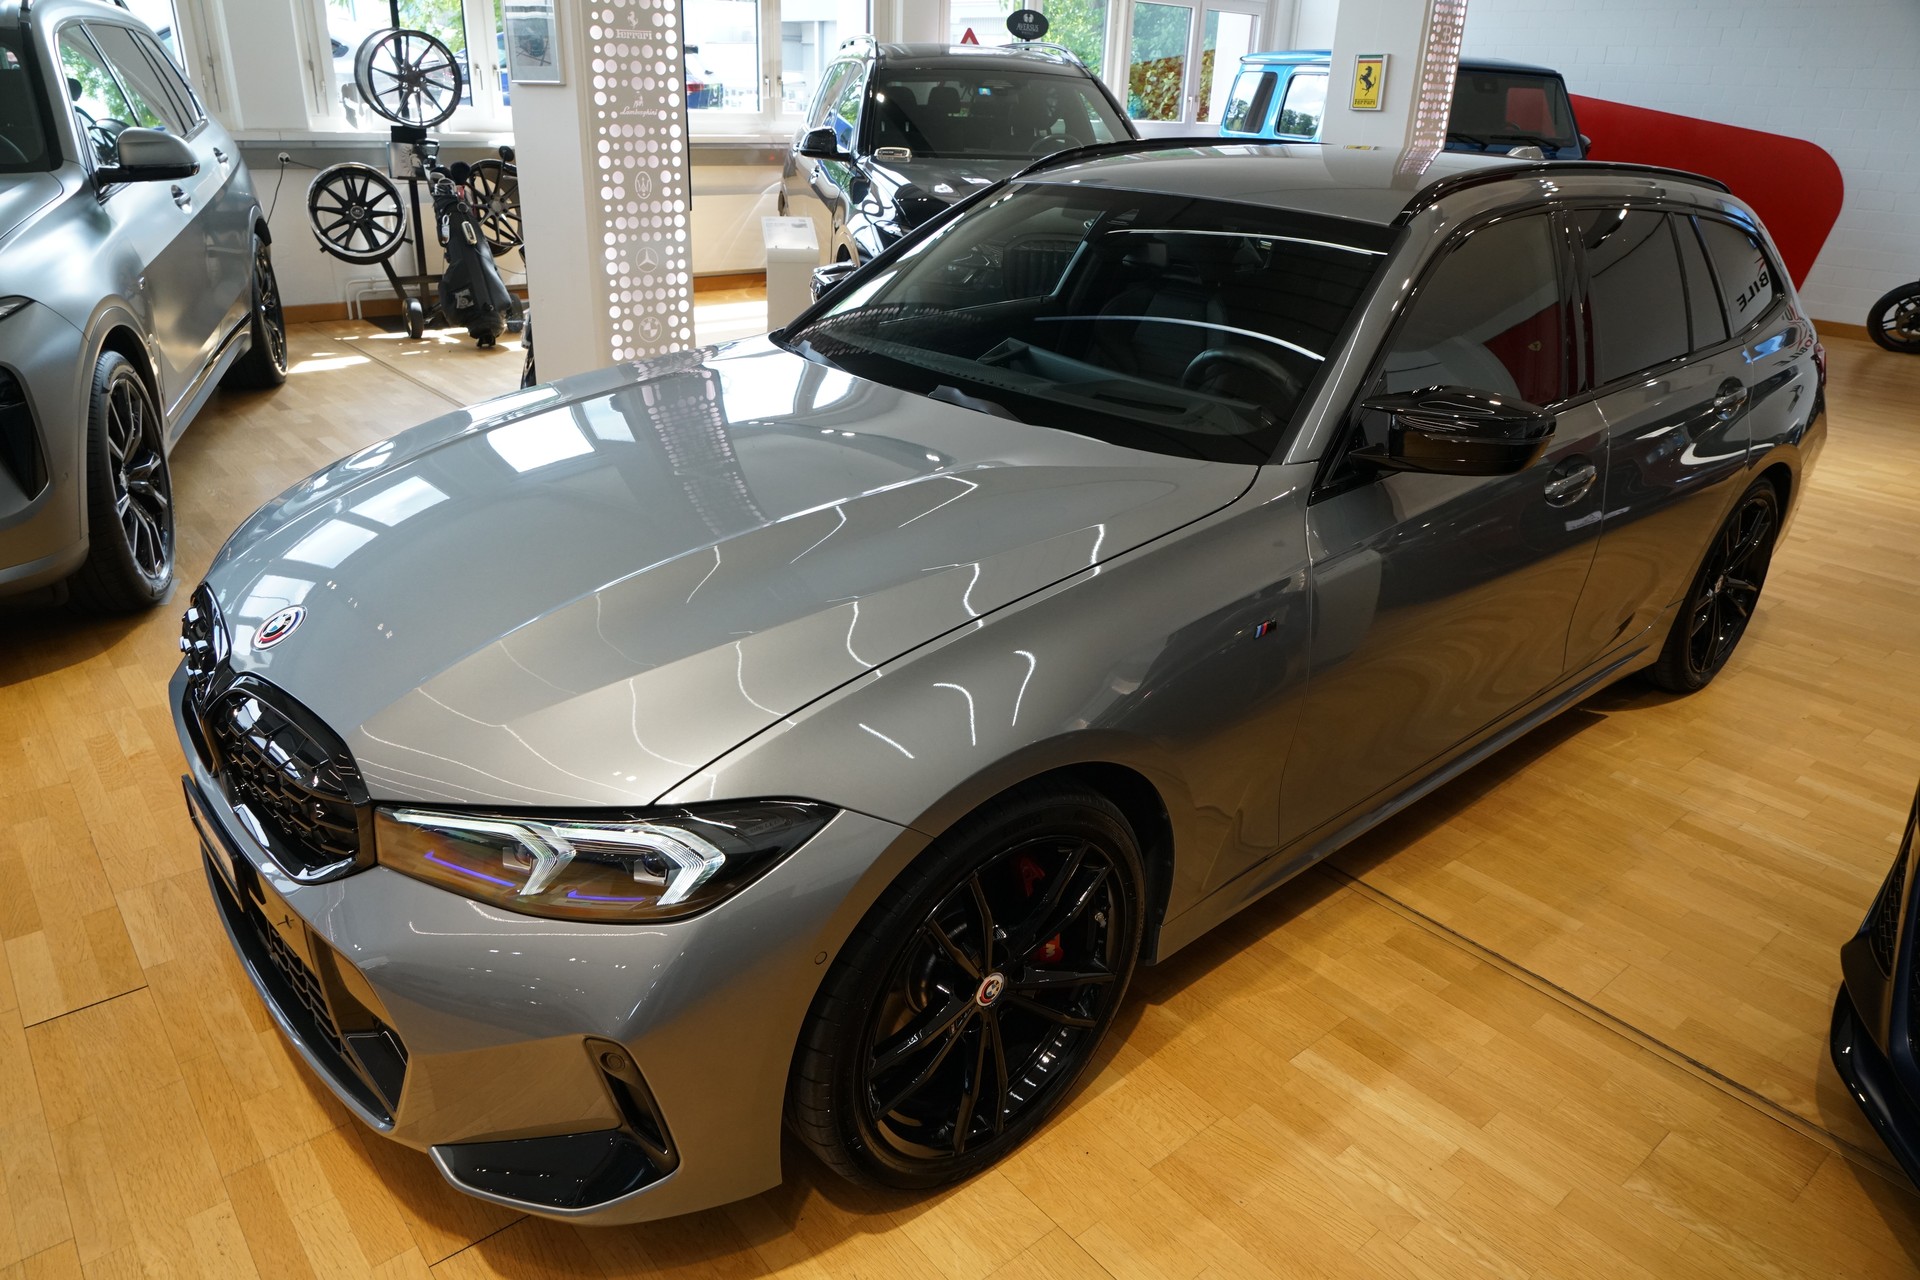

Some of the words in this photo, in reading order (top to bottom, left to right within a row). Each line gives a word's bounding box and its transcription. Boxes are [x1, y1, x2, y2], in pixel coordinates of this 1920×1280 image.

[615, 28, 653, 40] Ferrari
[1354, 98, 1376, 106] Ferrari
[619, 105, 659, 118] Lamborghini
